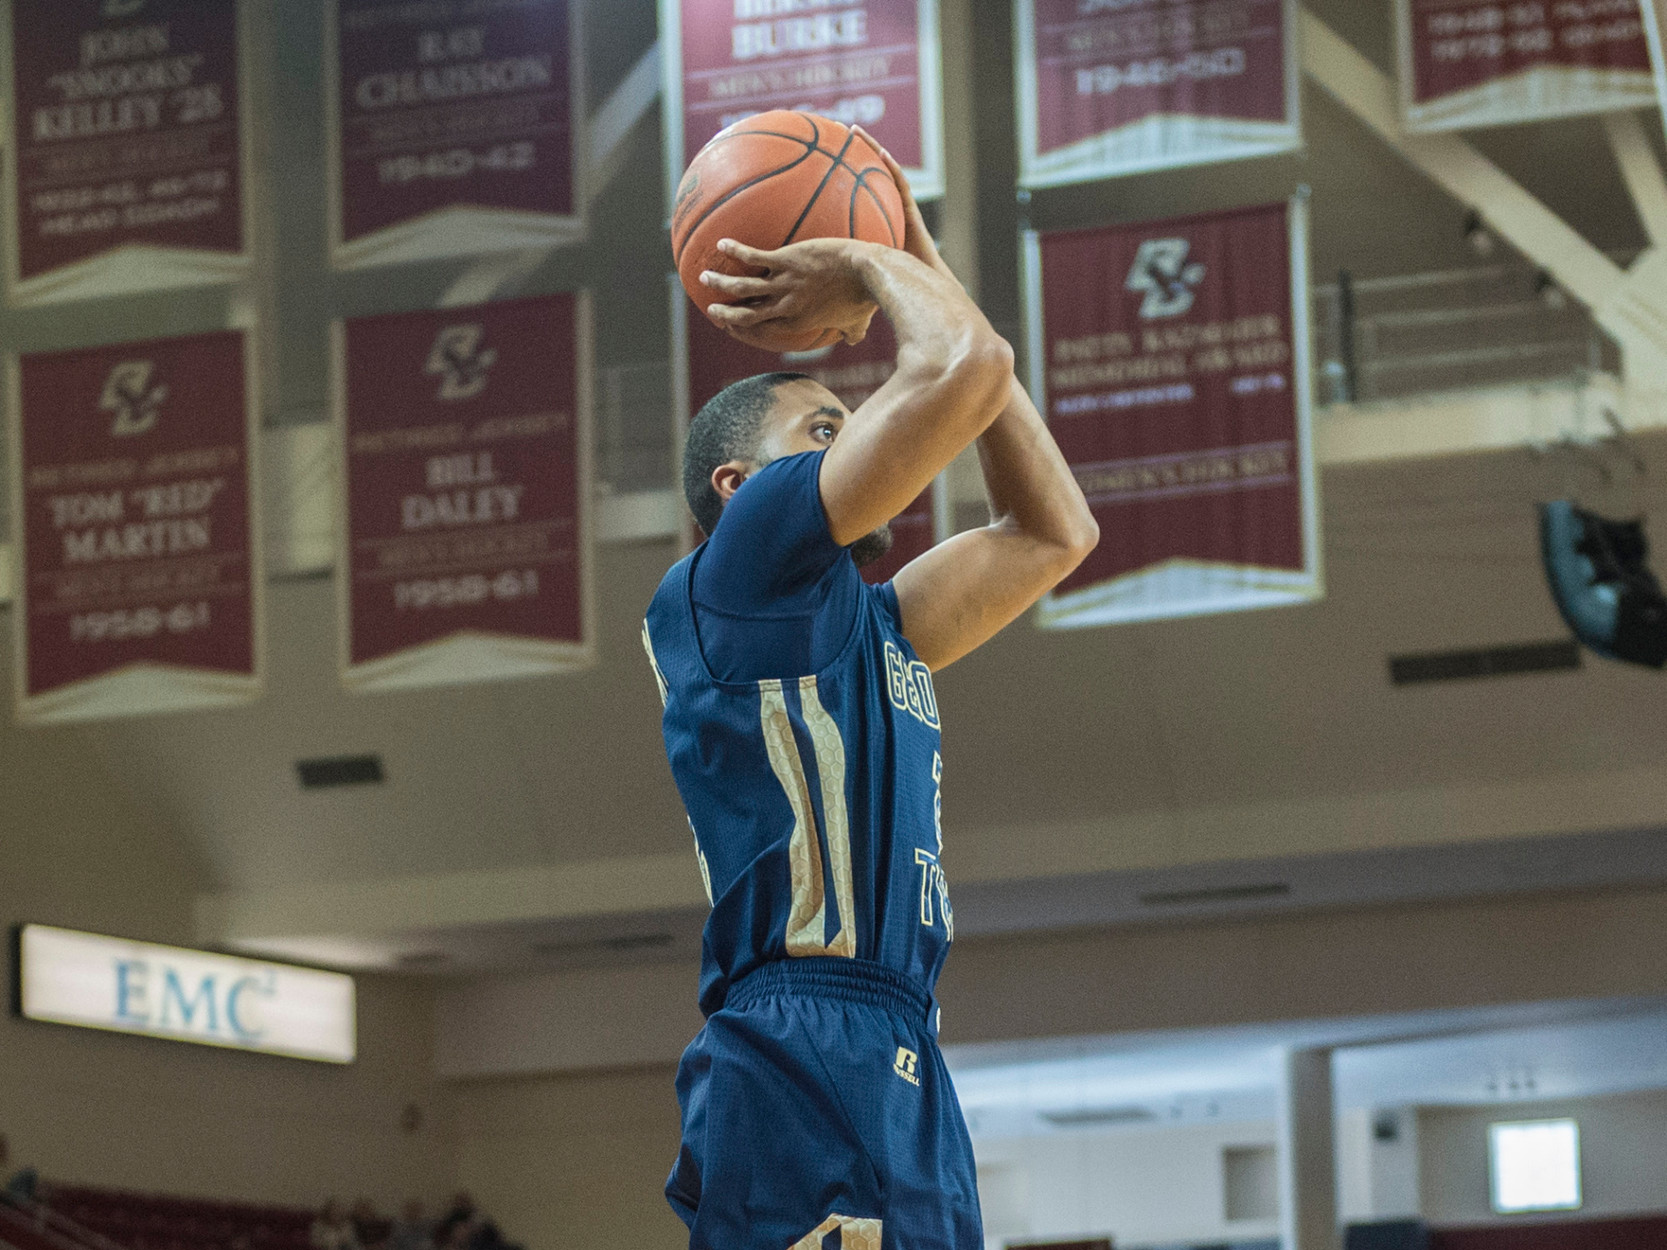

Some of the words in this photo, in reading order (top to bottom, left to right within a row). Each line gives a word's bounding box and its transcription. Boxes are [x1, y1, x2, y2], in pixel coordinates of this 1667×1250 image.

[426, 452, 496, 487] BILL
[49, 492, 124, 529] TOM
[401, 484, 524, 531] DALEY
[63, 516, 212, 564] MARTIN
